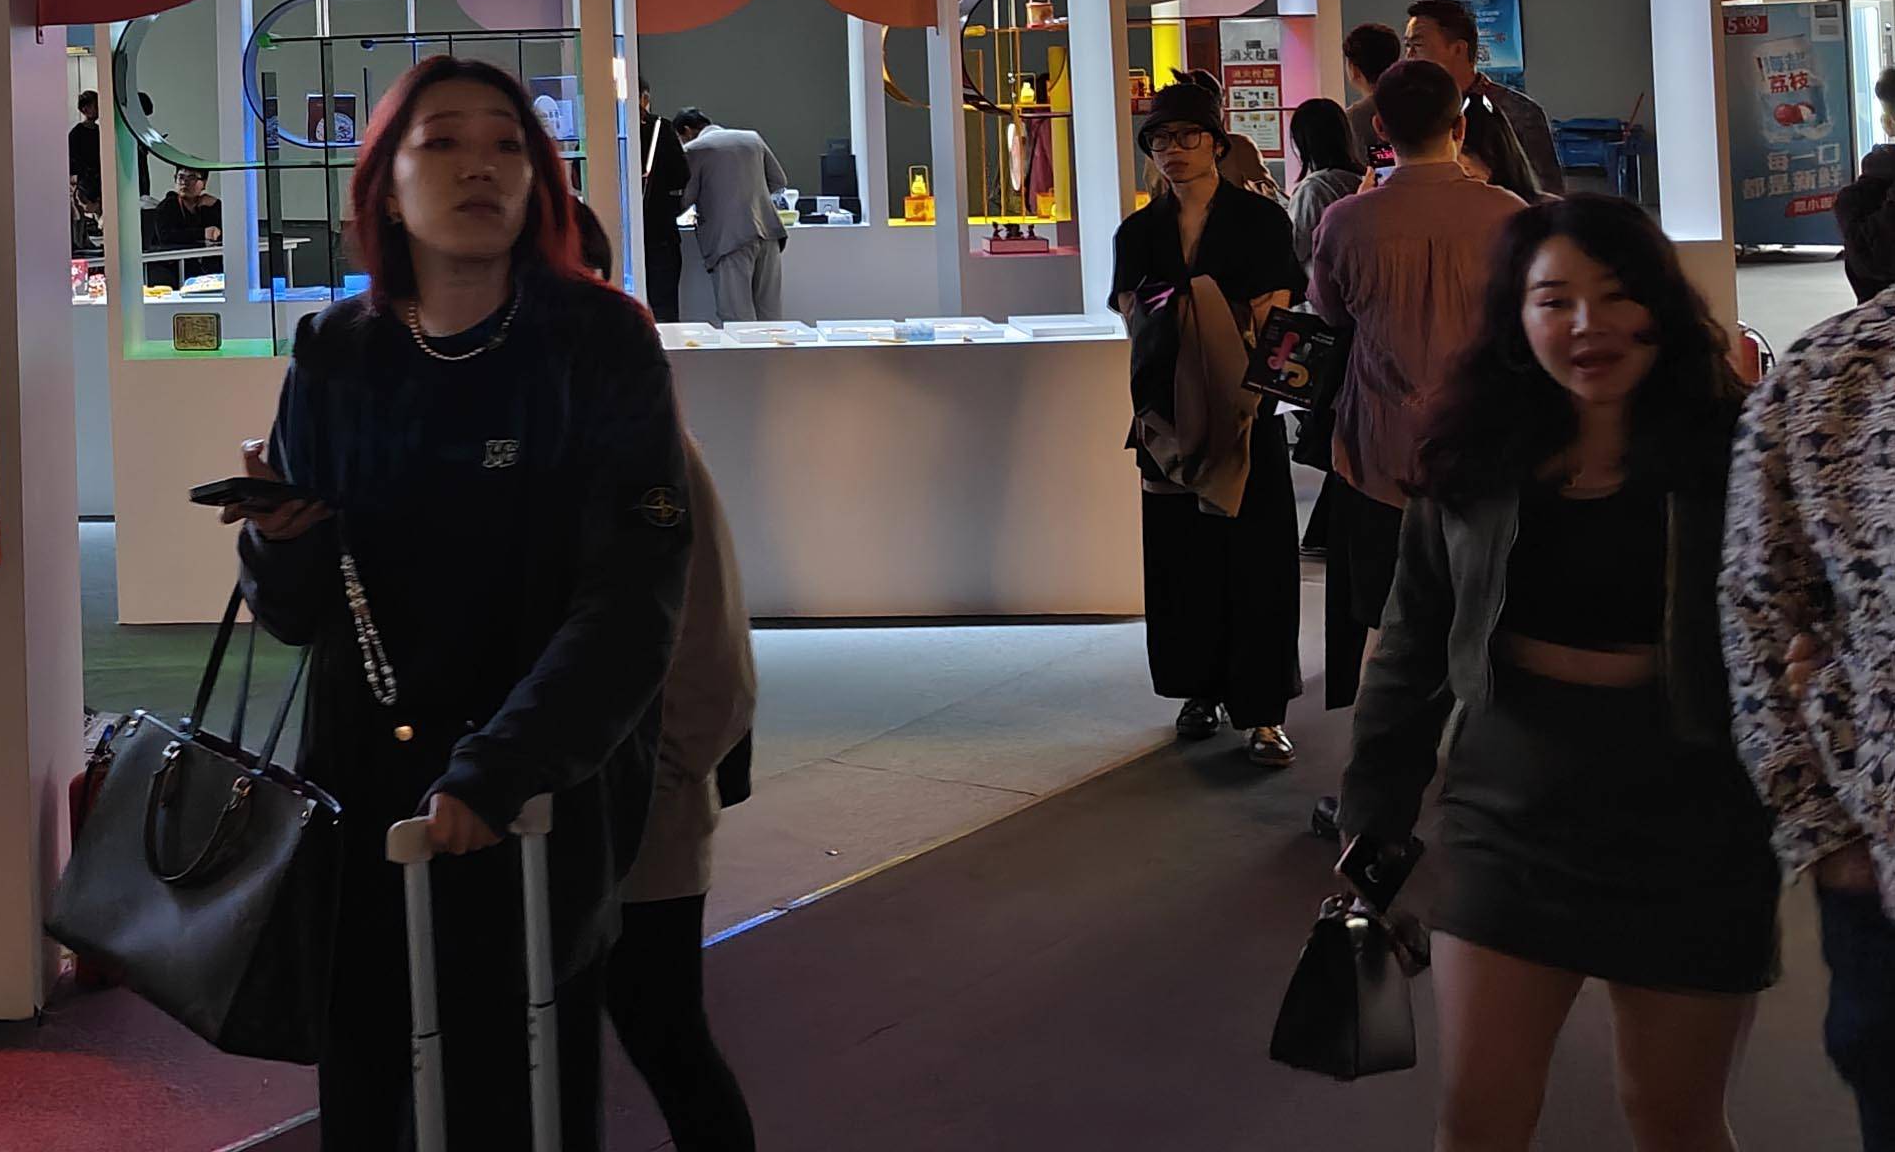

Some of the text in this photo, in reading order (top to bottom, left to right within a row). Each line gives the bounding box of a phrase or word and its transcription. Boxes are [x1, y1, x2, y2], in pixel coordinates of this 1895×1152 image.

[1768, 71, 1810, 94] 荔枝
[1767, 143, 1841, 171] 每一口
